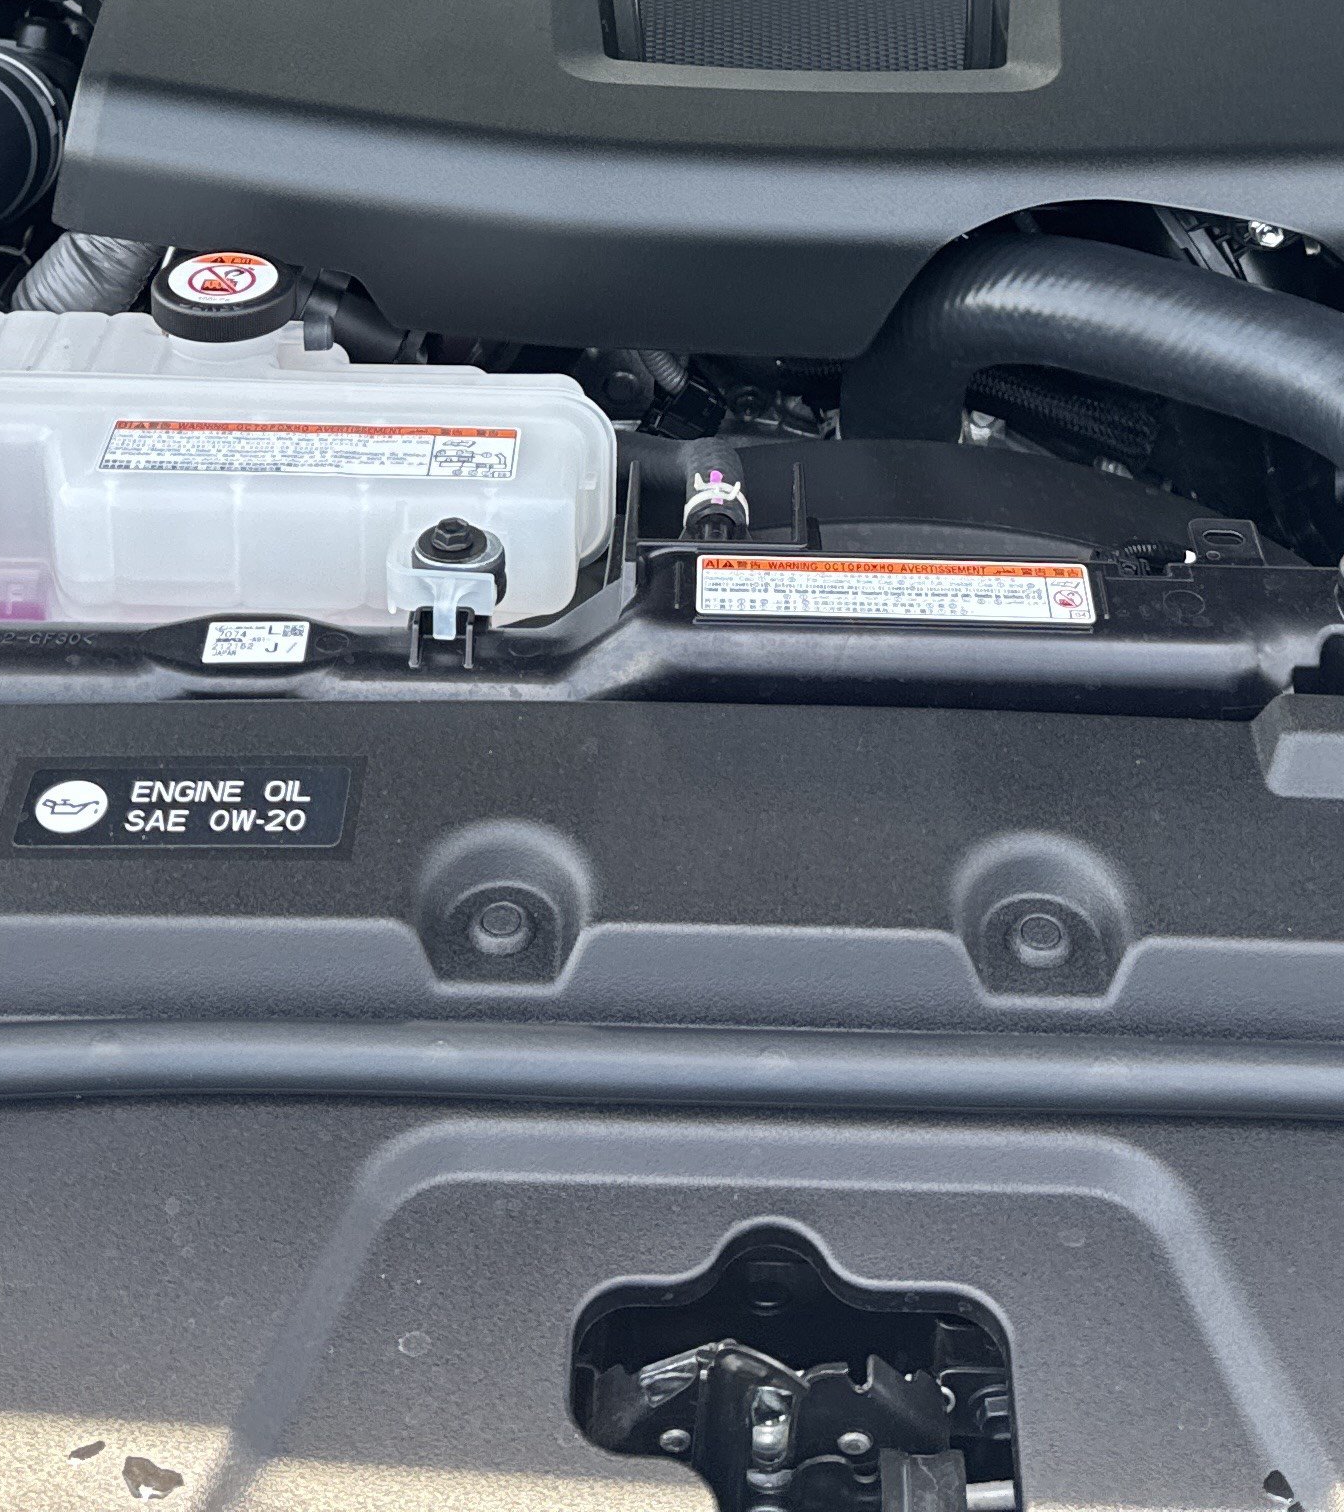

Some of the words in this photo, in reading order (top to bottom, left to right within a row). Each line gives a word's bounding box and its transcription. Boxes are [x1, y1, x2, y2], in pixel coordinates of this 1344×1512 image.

[179, 422, 229, 431] WARNING
[768, 561, 819, 571] WARNING
[900, 564, 987, 575] AVERTISSEMENT
[131, 780, 245, 803] ENGINE
[263, 780, 312, 803] OIL
[124, 809, 190, 832] SAE
[208, 809, 306, 832] 0W-20
